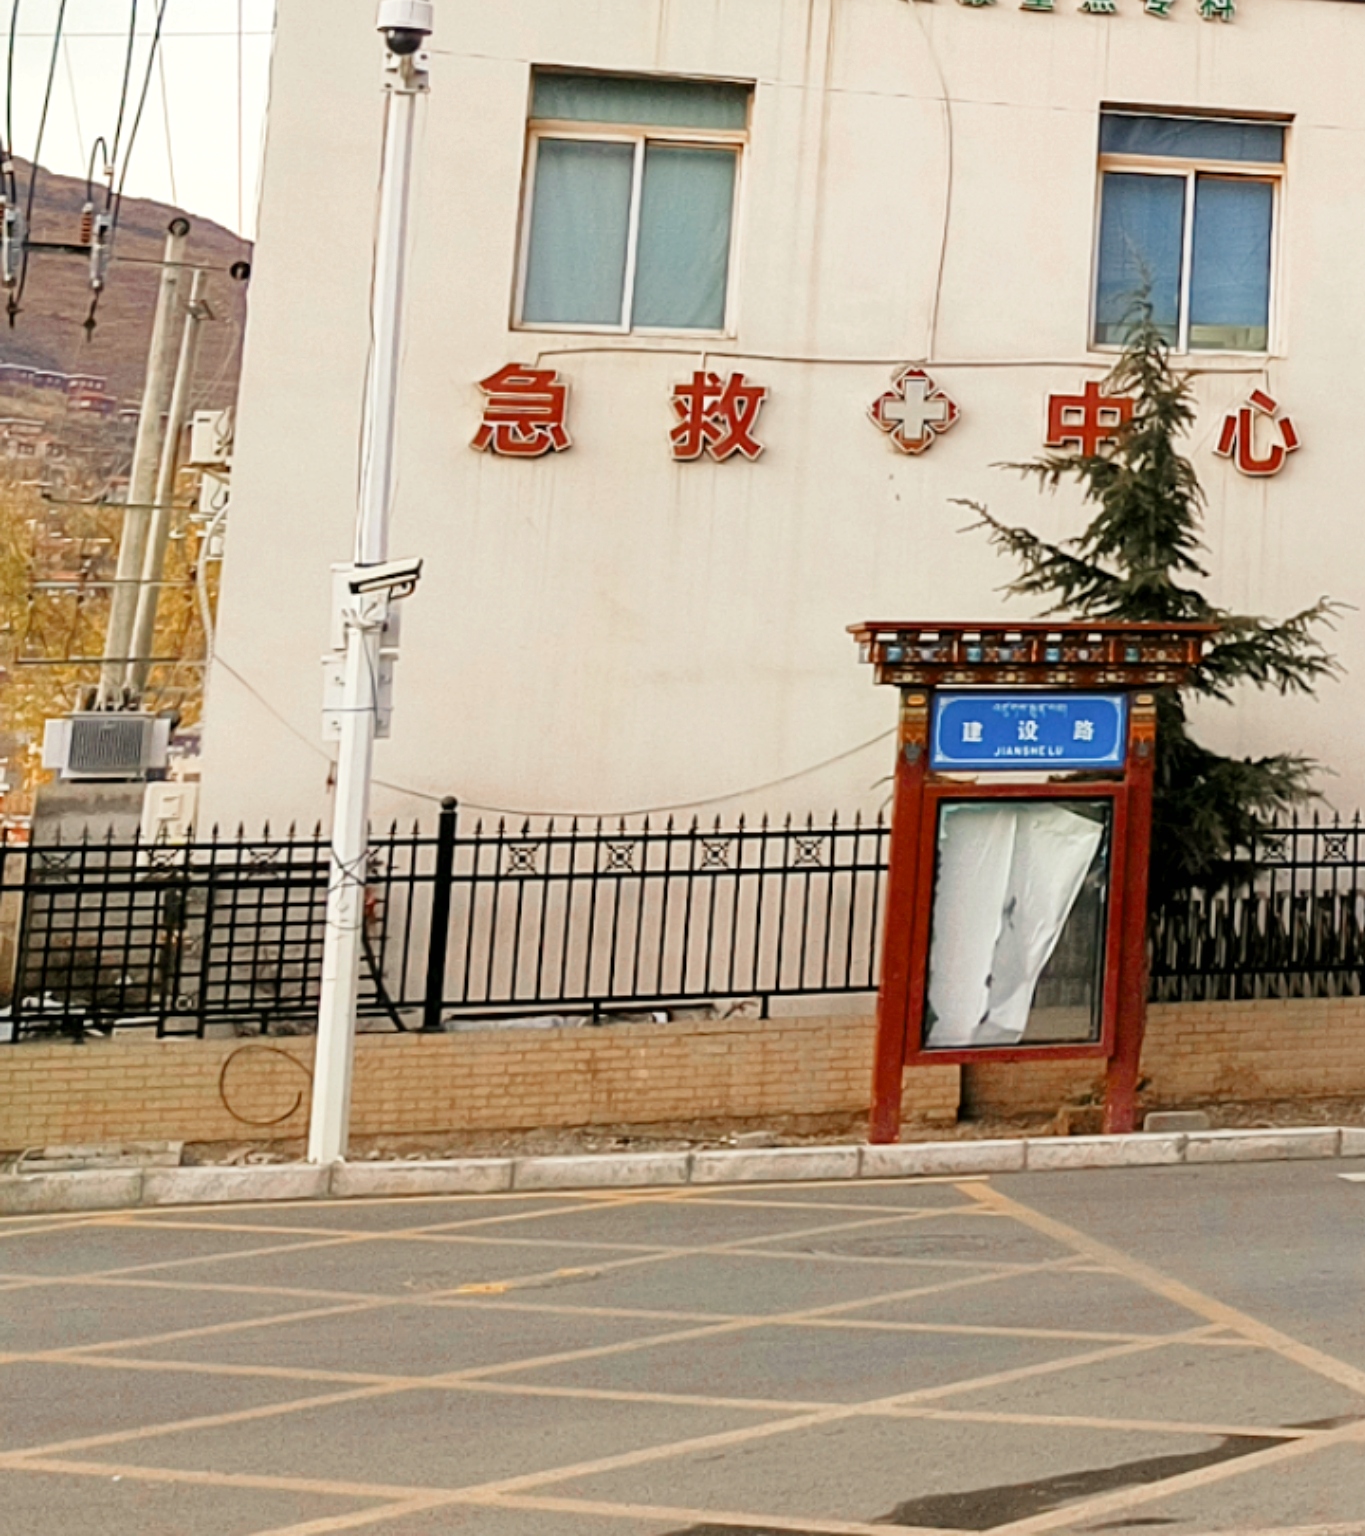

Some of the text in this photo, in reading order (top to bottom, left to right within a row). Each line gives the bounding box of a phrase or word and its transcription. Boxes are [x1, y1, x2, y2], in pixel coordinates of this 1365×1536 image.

[961, 719, 1095, 743] 建设路
[993, 745, 1064, 757] JIANSHE LU
